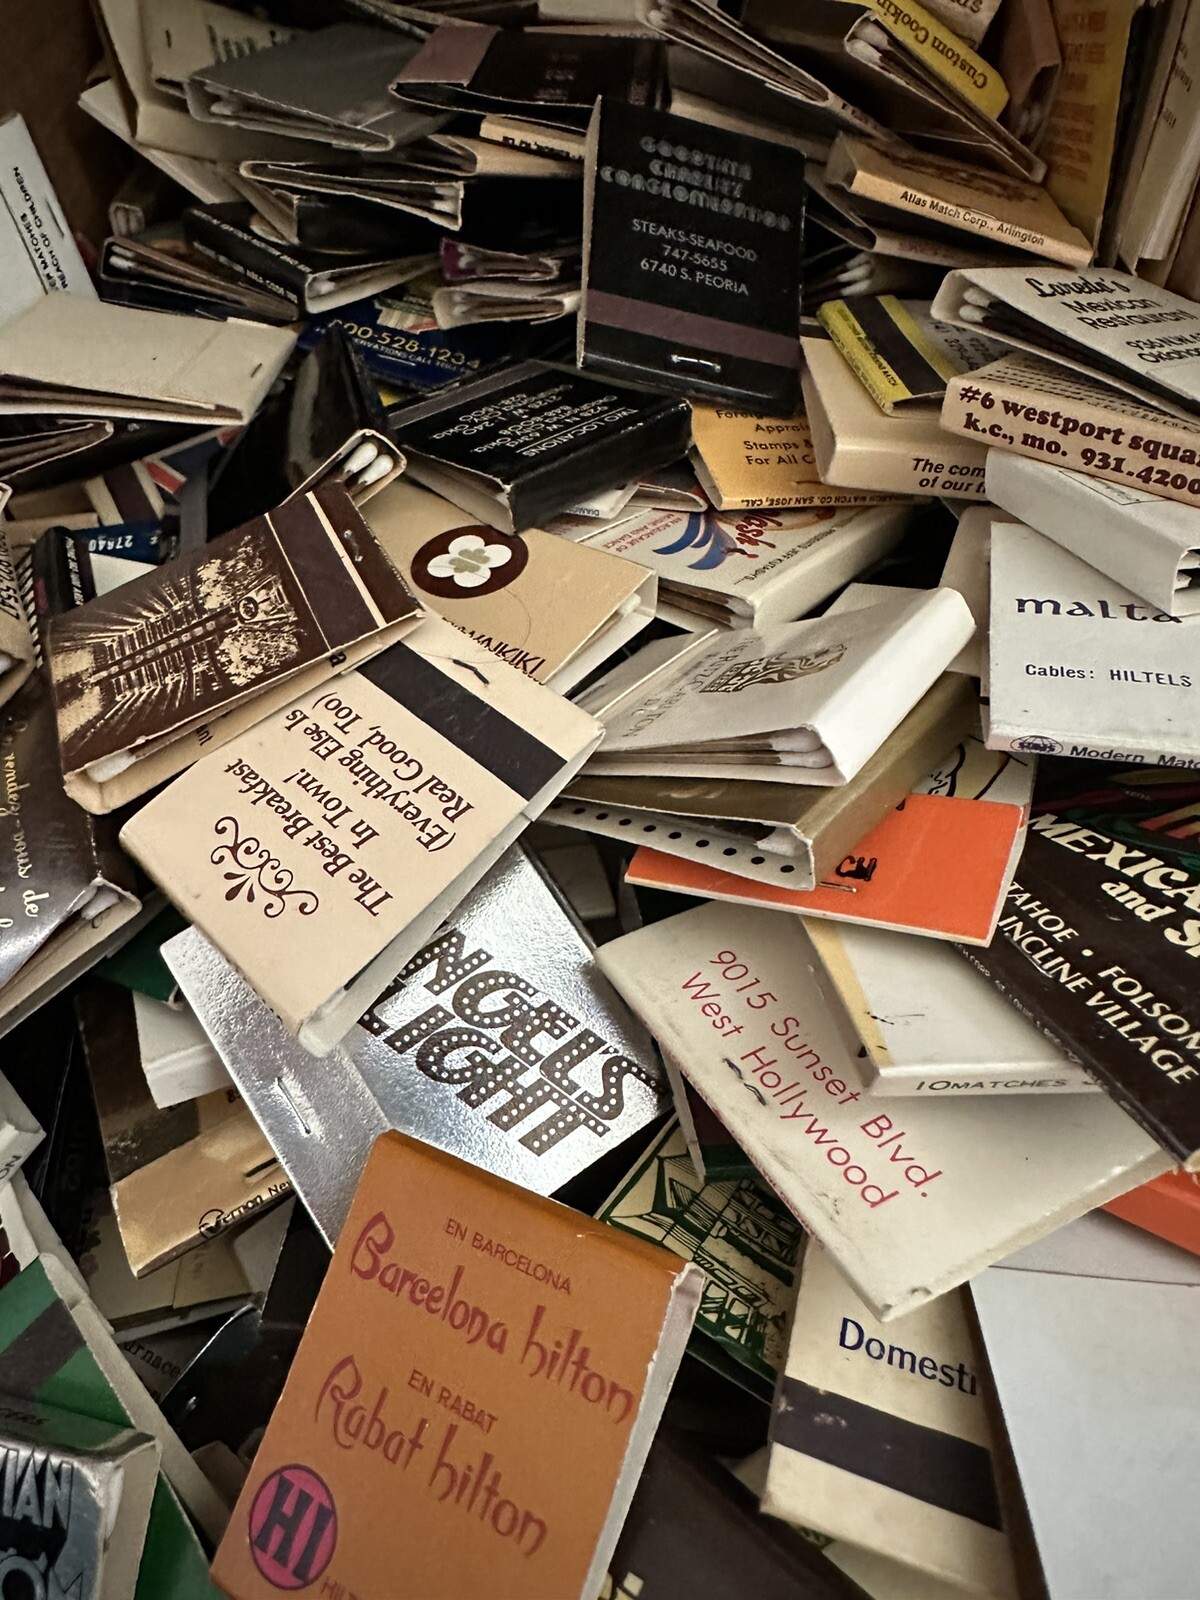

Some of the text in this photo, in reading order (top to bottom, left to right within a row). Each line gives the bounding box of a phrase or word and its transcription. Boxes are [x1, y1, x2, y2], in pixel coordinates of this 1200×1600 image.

[931, 36, 988, 89] Custom
[12, 166, 68, 290] REACH OF CHILDREN
[631, 218, 757, 262] STEAKS-SEAFOOD
[900, 190, 927, 208] Atlas
[928, 200, 960, 220] Match
[997, 220, 1044, 246] Arlington
[20, 212, 50, 271] MATCHES
[640, 258, 749, 296] 6740 S. PEORIA
[1061, 298, 1162, 314] Mexican
[1077, 309, 1199, 330] Restaurant
[522, 408, 639, 457] TWO LOCATIONS
[743, 440, 799, 451] Stamps
[755, 422, 811, 435] Apprai
[960, 385, 996, 408] #6
[1000, 399, 1126, 446] westport
[1128, 435, 1200, 467] squa
[963, 413, 1015, 442] k.c.,
[1021, 432, 1068, 457] mo.
[745, 455, 770, 466] For
[777, 454, 799, 466] All
[912, 458, 944, 473] The
[741, 498, 764, 508] CAL.
[765, 496, 792, 507] JOSE,
[793, 495, 815, 506] SAN
[816, 495, 833, 505] CO.
[919, 477, 940, 490] of
[941, 479, 971, 492] our
[1015, 596, 1182, 624] malta
[1025, 664, 1193, 688] Cables: HILTELS
[312, 692, 474, 823] Real Good, Too)
[1070, 745, 1144, 764] Modern
[285, 709, 456, 852] (Everything Else Is
[283, 768, 380, 850] In Town!
[224, 757, 393, 917] The Best Breakfast
[22, 889, 50, 918] de
[1007, 881, 1079, 943] TAHOE
[1100, 881, 1177, 922] and
[1000, 915, 1094, 993] INCLINE
[1085, 990, 1199, 1086] VILLAGE
[400, 927, 670, 1121] NGEL'S
[357, 977, 611, 1157] LIGHT
[709, 950, 943, 1199] 9015 Sunset Blvd.
[681, 971, 900, 1210] West Hollywood
[268, 1179, 294, 1198] Ne
[445, 1217, 572, 1295] EN BARCELONA
[350, 1210, 635, 1425] Barcelona hilton
[407, 1368, 499, 1435] EN RABAT
[315, 1354, 548, 1557] Rabat hilton
